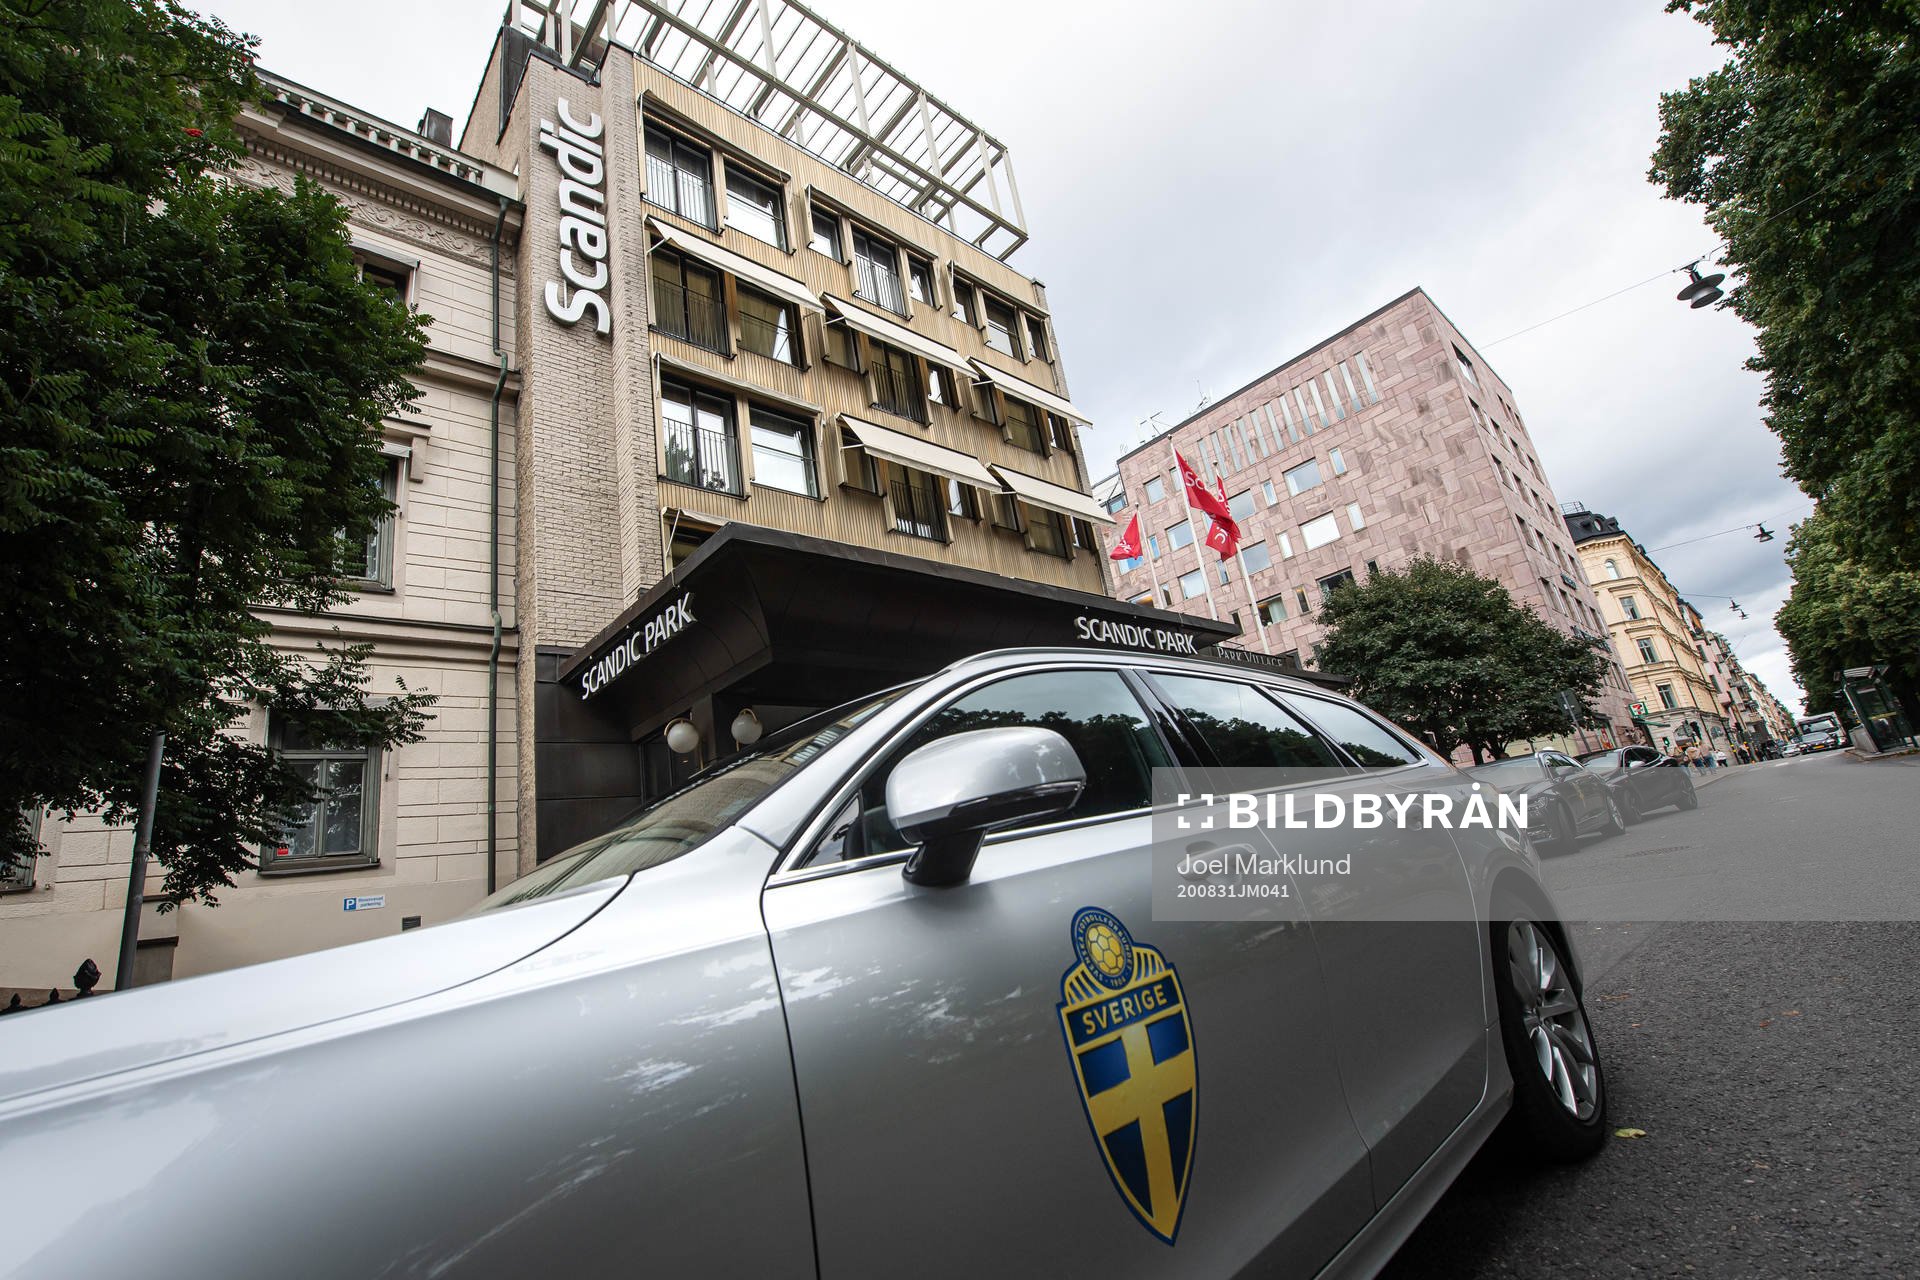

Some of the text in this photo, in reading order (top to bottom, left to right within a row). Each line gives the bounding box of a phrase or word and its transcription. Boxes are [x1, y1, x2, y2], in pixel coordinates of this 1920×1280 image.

[539, 96, 611, 335] Scandic
[582, 592, 694, 700] SCANDIC PARK
[1076, 616, 1198, 655] SCANDIC PARK
[1082, 983, 1168, 1035] SVERIGE
